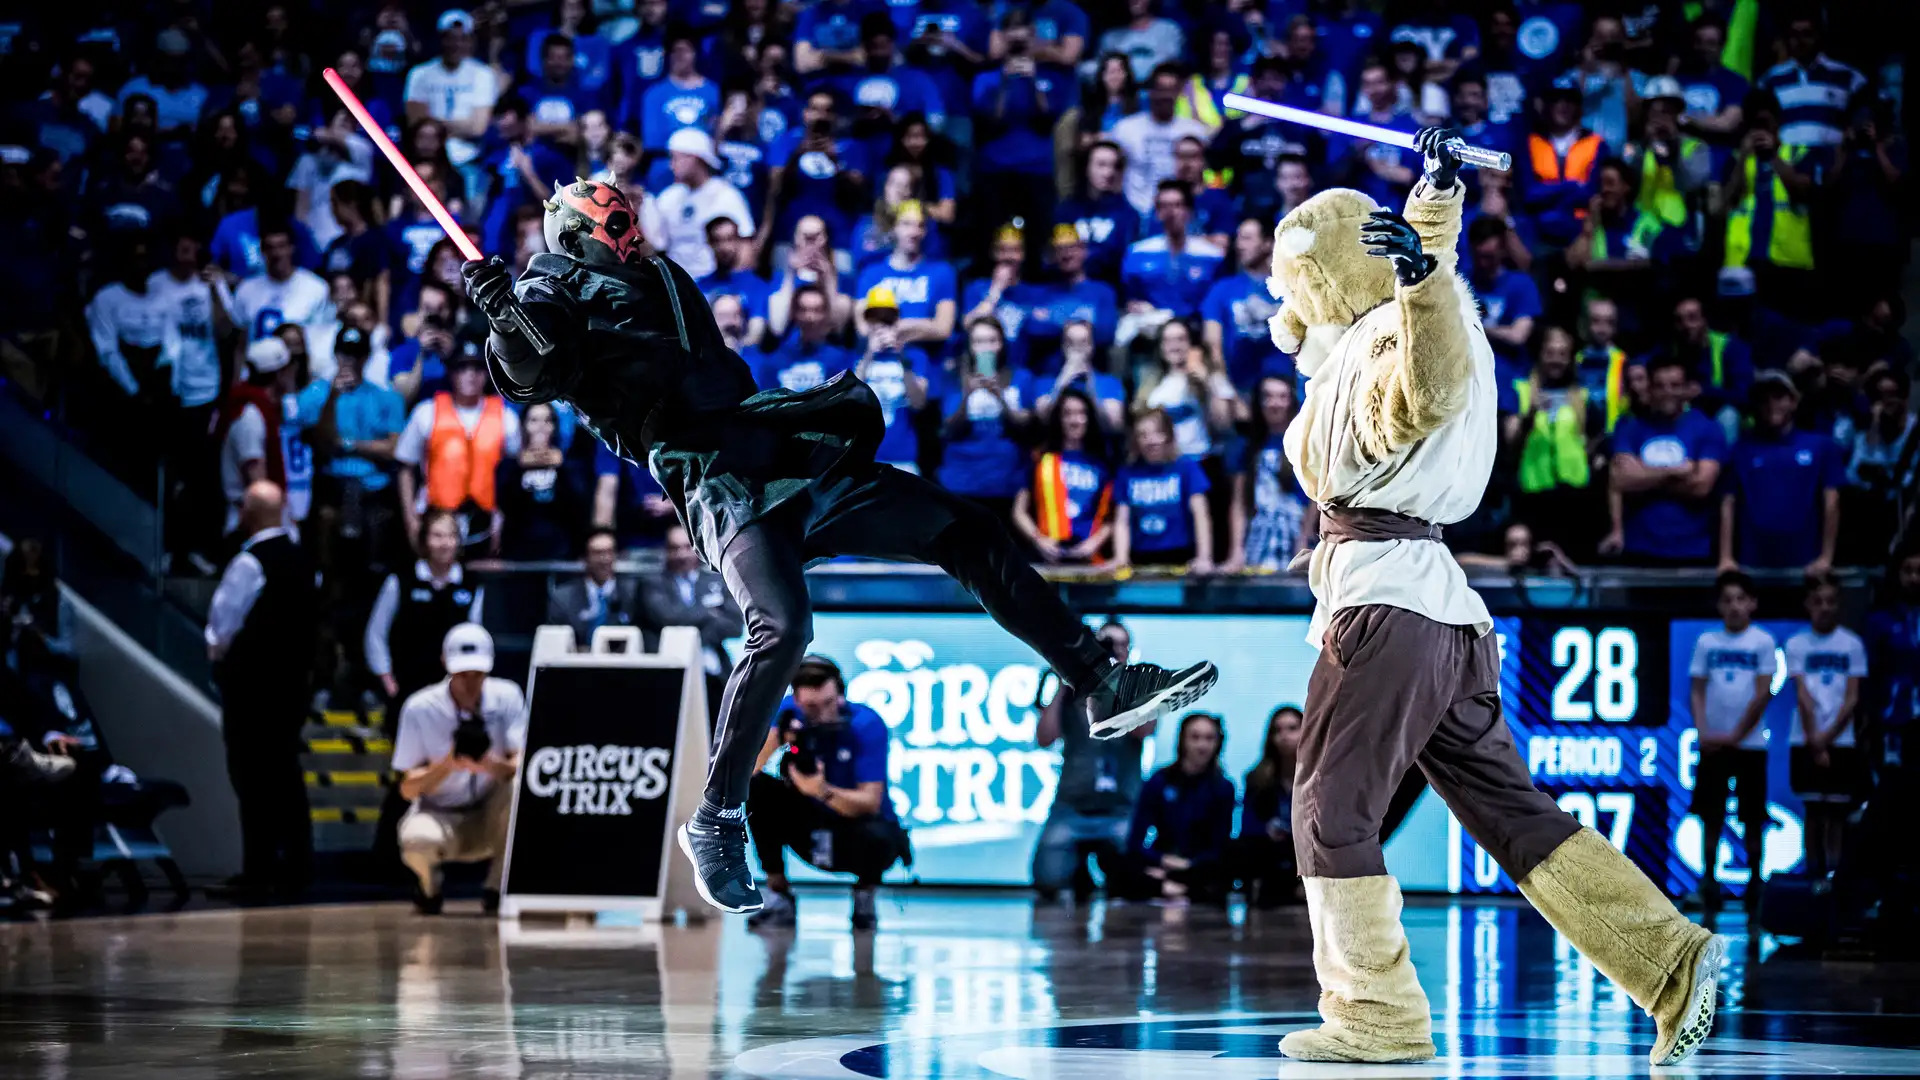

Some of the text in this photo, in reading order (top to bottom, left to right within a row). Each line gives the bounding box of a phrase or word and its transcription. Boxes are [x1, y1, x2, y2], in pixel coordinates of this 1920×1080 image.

[1551, 626, 1639, 722] 28
[526, 744, 671, 800] CIRCUS
[1528, 735, 1622, 777] PERIOD
[1639, 736, 1658, 777] 2
[556, 781, 633, 815] TRIX
